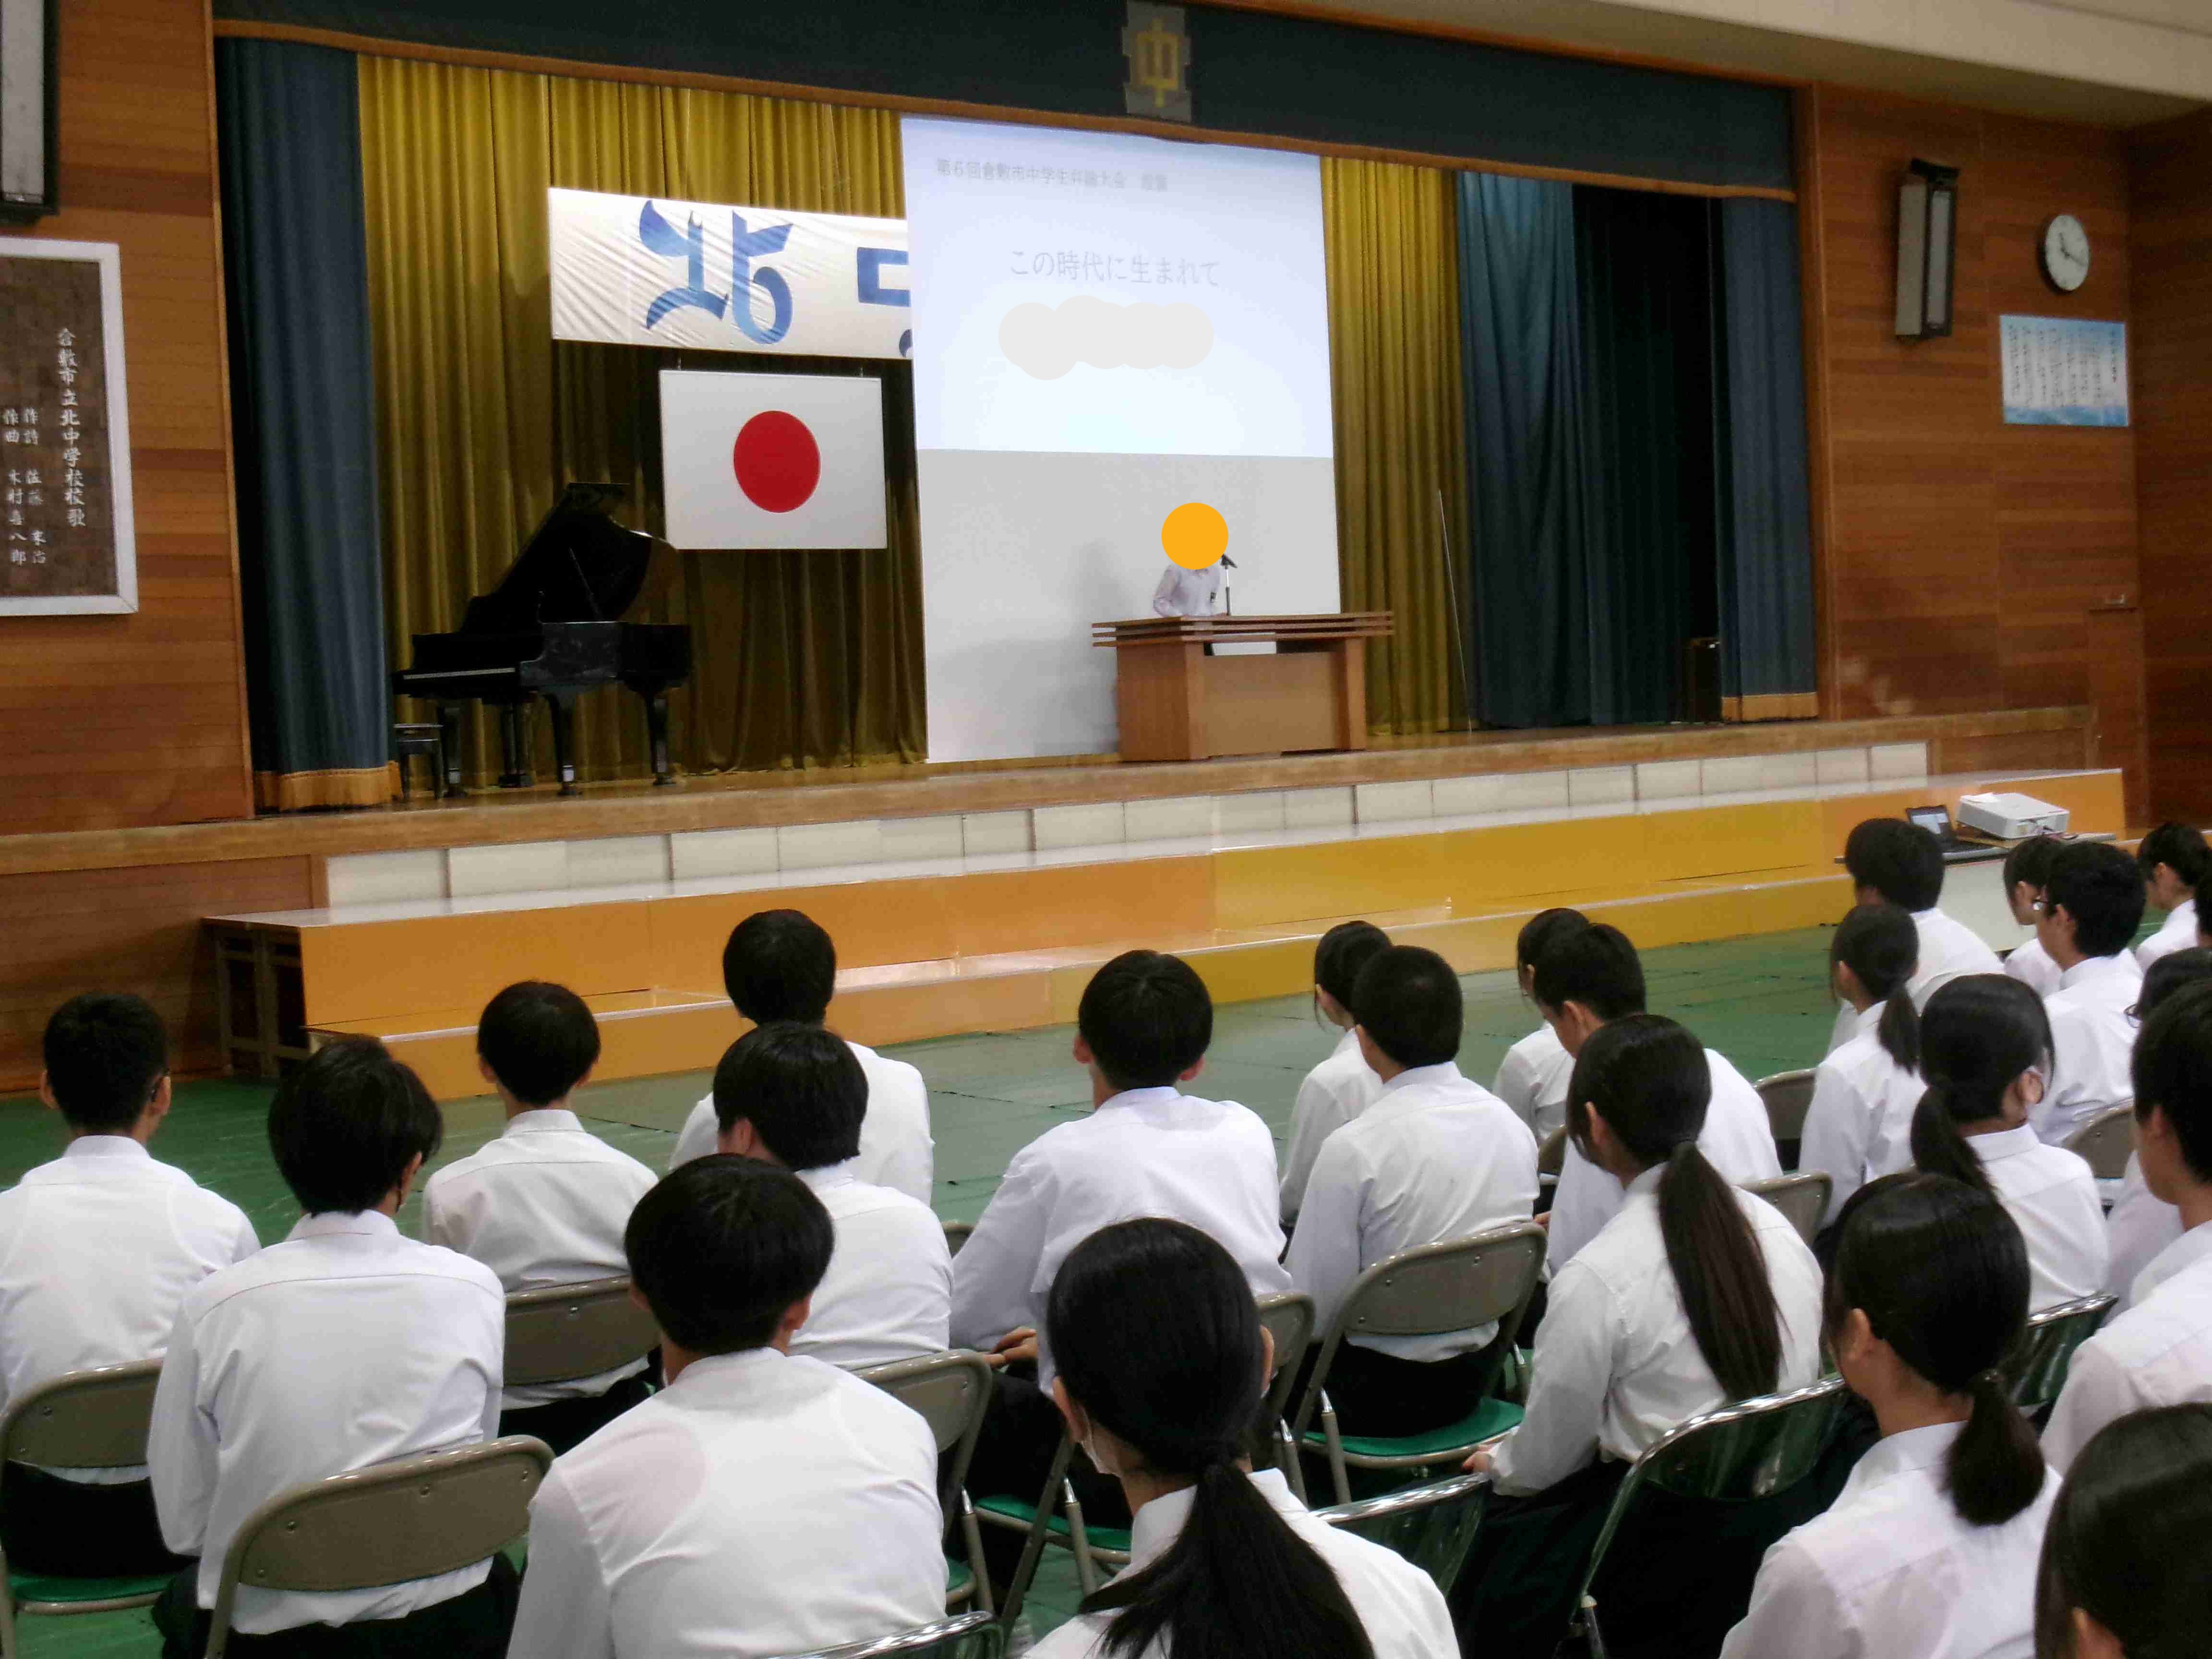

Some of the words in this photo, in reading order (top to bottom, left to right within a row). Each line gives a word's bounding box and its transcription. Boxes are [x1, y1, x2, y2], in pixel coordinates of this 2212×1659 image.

[1010, 249, 1220, 288] この時代に生まれて
[56, 327, 86, 527] 倉敷市立北中学校校歌
